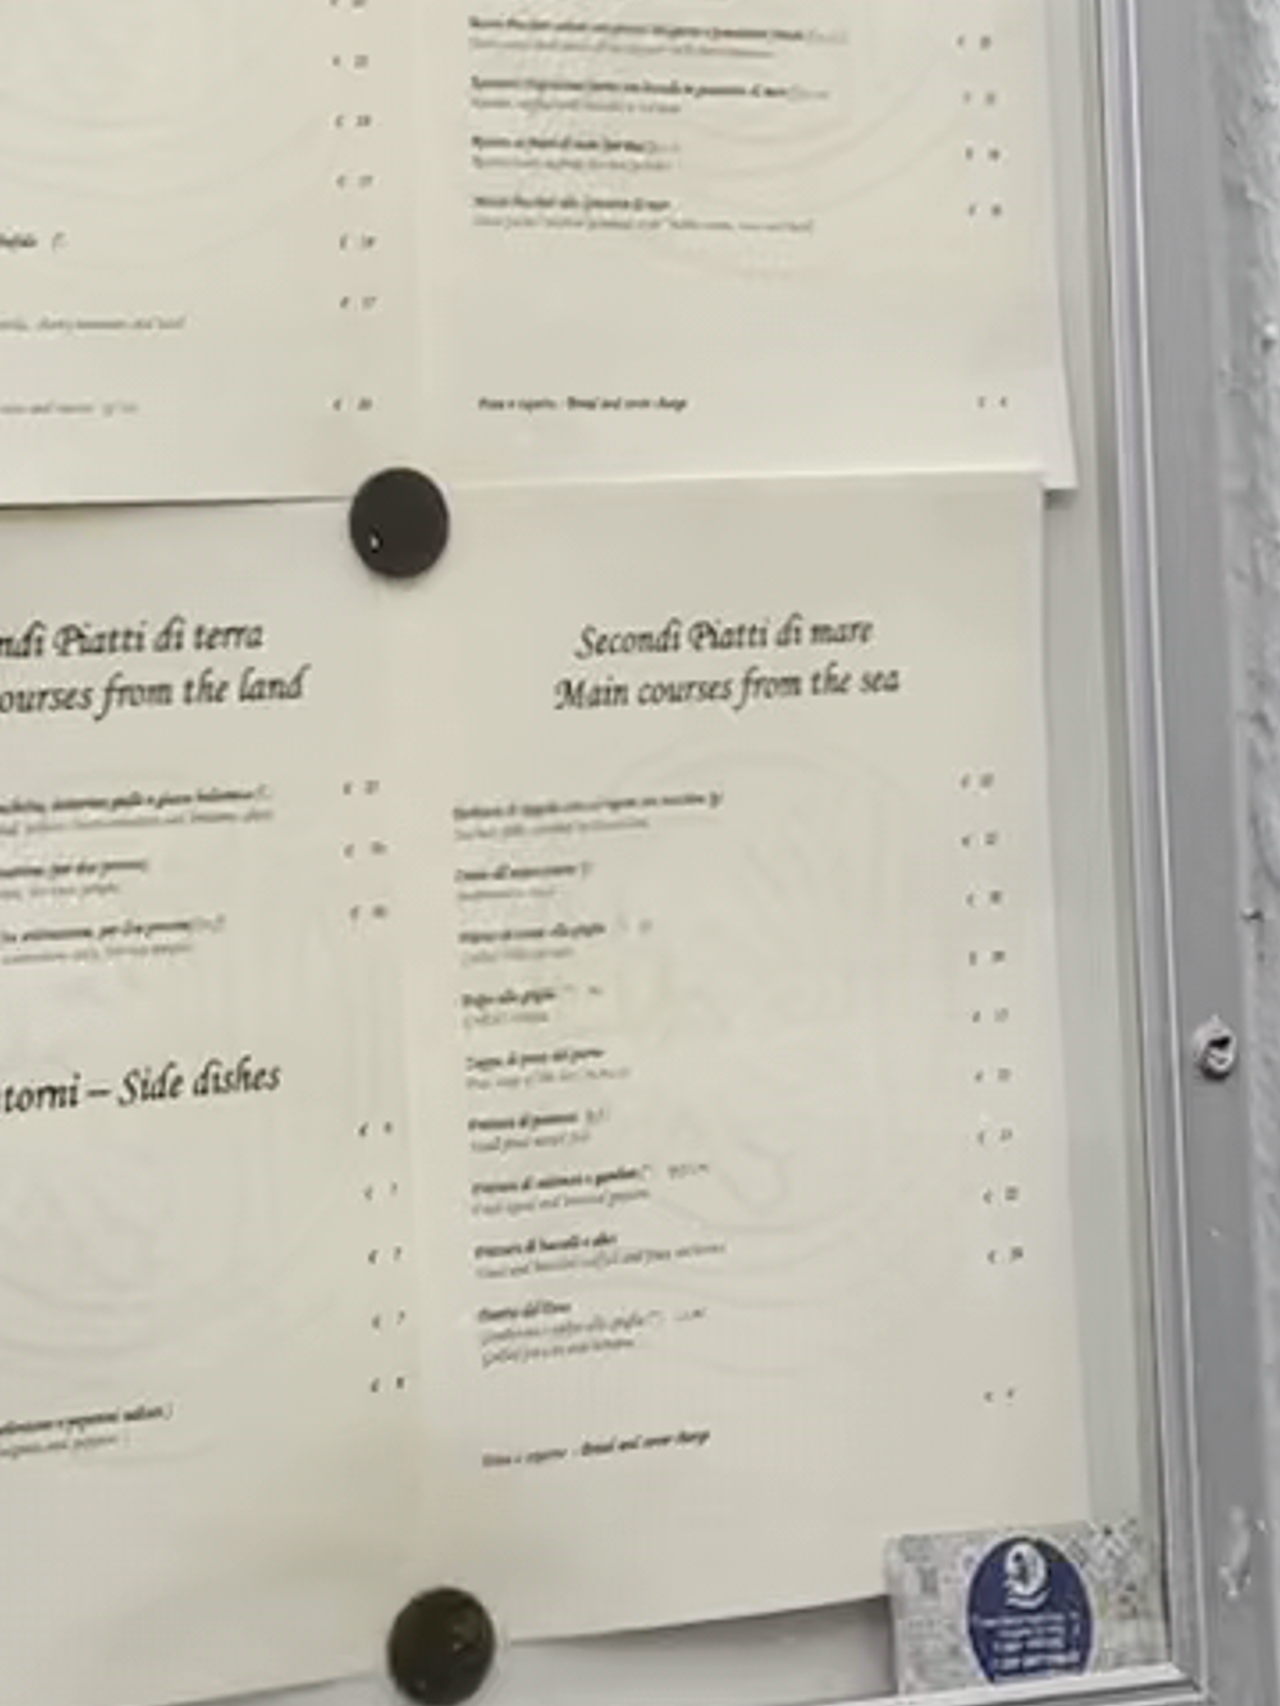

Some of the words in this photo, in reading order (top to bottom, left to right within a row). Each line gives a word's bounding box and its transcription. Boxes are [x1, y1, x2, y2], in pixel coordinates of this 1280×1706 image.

[52, 620, 148, 658] Piatti
[152, 615, 186, 653] di
[193, 624, 263, 652] terra
[575, 617, 682, 660] Secondi
[687, 618, 770, 653] Piatti
[775, 612, 803, 648] di
[810, 620, 874, 646] mare
[94, 670, 174, 722] from
[183, 666, 230, 705] the
[238, 663, 312, 703] land
[554, 675, 629, 710] Main
[637, 677, 733, 705] courses
[733, 665, 803, 712] from
[810, 659, 851, 696] the
[862, 669, 900, 694] sea
[117, 1061, 184, 1107] Side
[192, 1055, 282, 1094] dishes
